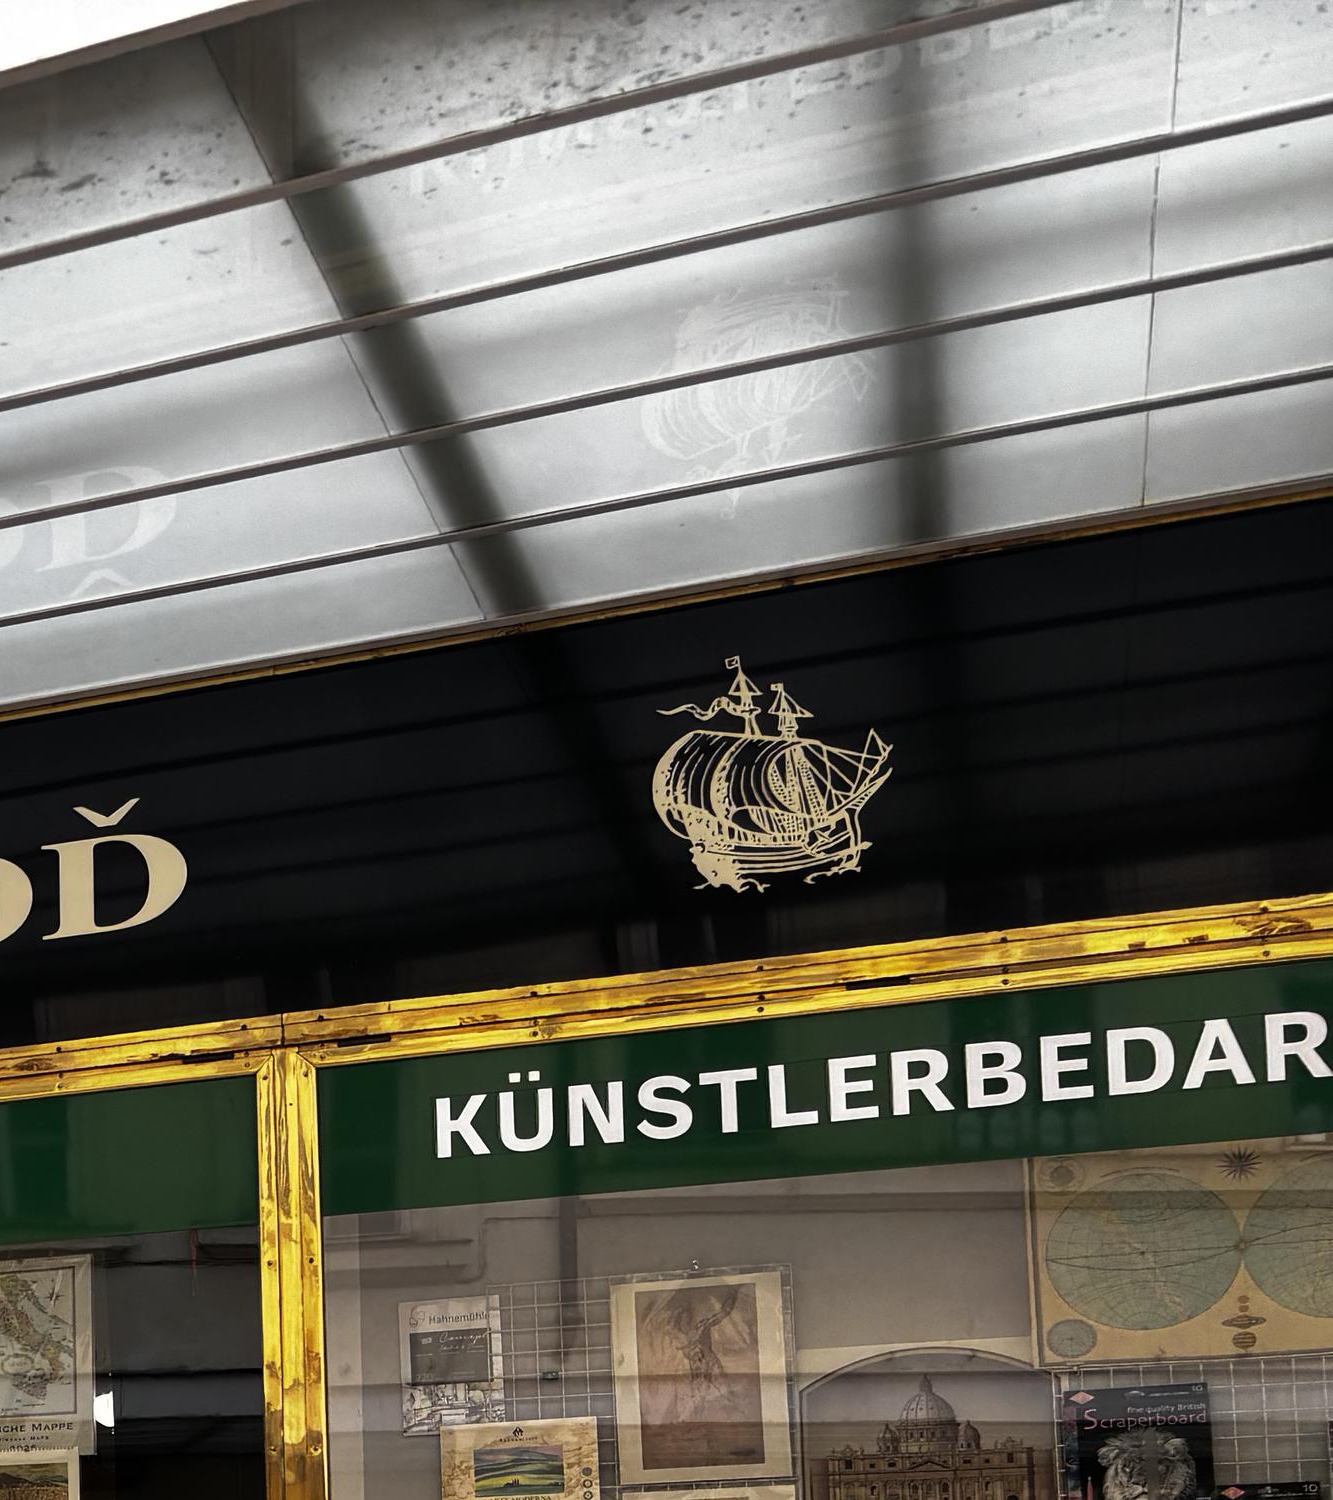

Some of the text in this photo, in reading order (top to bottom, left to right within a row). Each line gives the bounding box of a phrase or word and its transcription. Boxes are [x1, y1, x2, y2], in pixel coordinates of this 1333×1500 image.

[435, 1011, 1333, 1160] KÜNSTLERBEDAR
[32, 1422, 74, 1432] MAPPE
[1083, 1407, 1207, 1431] Scraperboard
[1303, 1484, 1318, 1492] 10
